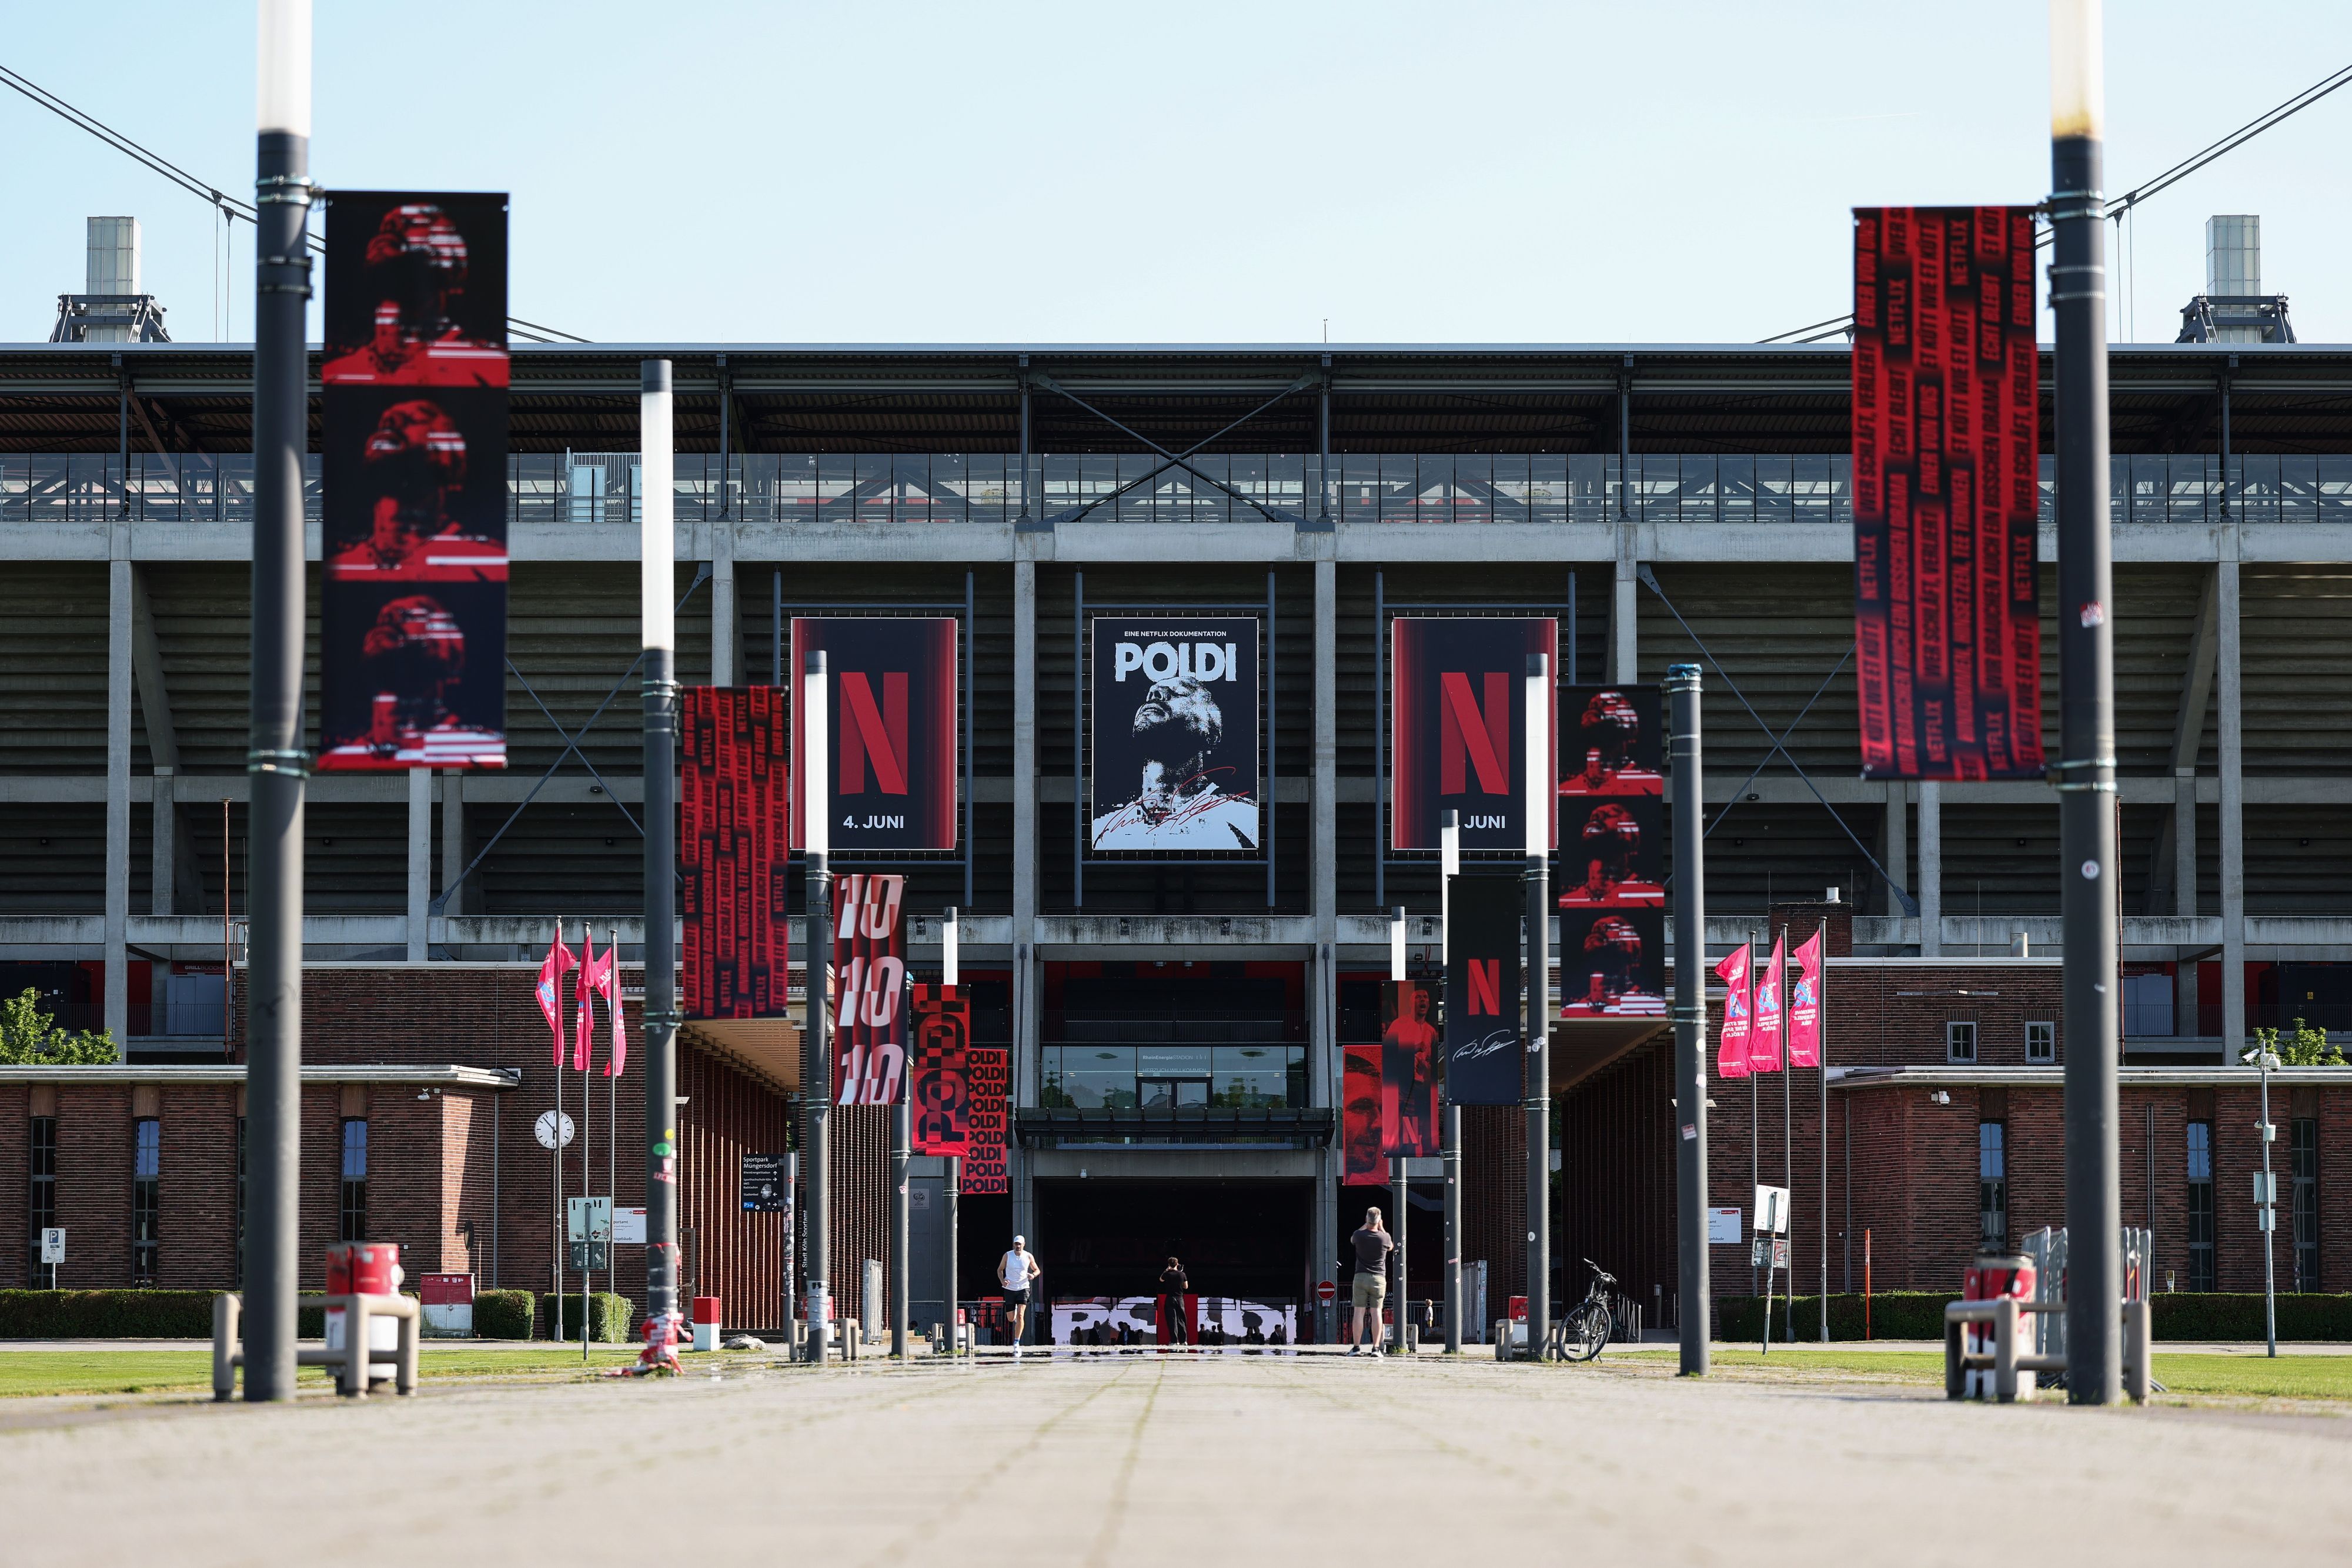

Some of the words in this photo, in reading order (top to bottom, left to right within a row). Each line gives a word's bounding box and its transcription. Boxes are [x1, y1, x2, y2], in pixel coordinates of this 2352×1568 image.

[1857, 218, 1876, 250] UNS
[2012, 216, 2032, 248] UNS
[1857, 252, 1876, 283] VON
[1919, 261, 1938, 279] ET
[1950, 219, 1969, 286] NETFLIX
[2012, 249, 2032, 282] VON
[1857, 285, 1876, 327] EINER
[1888, 279, 1907, 345] NETFLIX
[1919, 281, 1938, 309] WIE
[1980, 272, 2001, 322] BLEIBT
[2012, 283, 2032, 327] EINER
[1919, 352, 1938, 369] ET
[1950, 347, 1969, 365] ET
[1980, 323, 2001, 361] ECHT
[1950, 366, 1969, 395] WIE
[1919, 384, 1940, 417] UNS
[1982, 380, 2001, 434] DRAMA
[1919, 417, 1940, 450] VON
[1950, 436, 1969, 453] ET
[1919, 452, 1940, 495] EINER
[1859, 535, 1879, 600] NETFLIX
[2013, 535, 2032, 601] NETFLIX
[1115, 641, 1237, 682] POLDI
[736, 694, 747, 733] NETFLIX
[1925, 700, 1947, 763] NETFLIX
[701, 728, 713, 766] NETFLIX
[840, 672, 908, 795] N
[1441, 672, 1509, 795] N
[1985, 711, 2009, 770] NETFLIX
[843, 815, 859, 829] 4.
[862, 815, 904, 829] JUNI
[1464, 815, 1506, 829] JUNI
[684, 875, 696, 912] NETFLIX
[773, 874, 784, 912] NETFLIX
[838, 875, 904, 939] 10
[720, 970, 732, 1008] NETFLIX
[756, 975, 766, 1012] NETFLIX
[838, 956, 904, 1027] 10
[1468, 959, 1499, 1016] N
[838, 1044, 904, 1105] 10
[917, 1001, 966, 1142] POLDI
[969, 1051, 1001, 1065] OLDI
[969, 1114, 1001, 1129] OLDI
[1403, 1116, 1418, 1145] N
[966, 1162, 1007, 1177] POLDI
[969, 1146, 1001, 1161] OLDI
[963, 1178, 1005, 1193] POLDI
[50, 1231, 57, 1242] P
